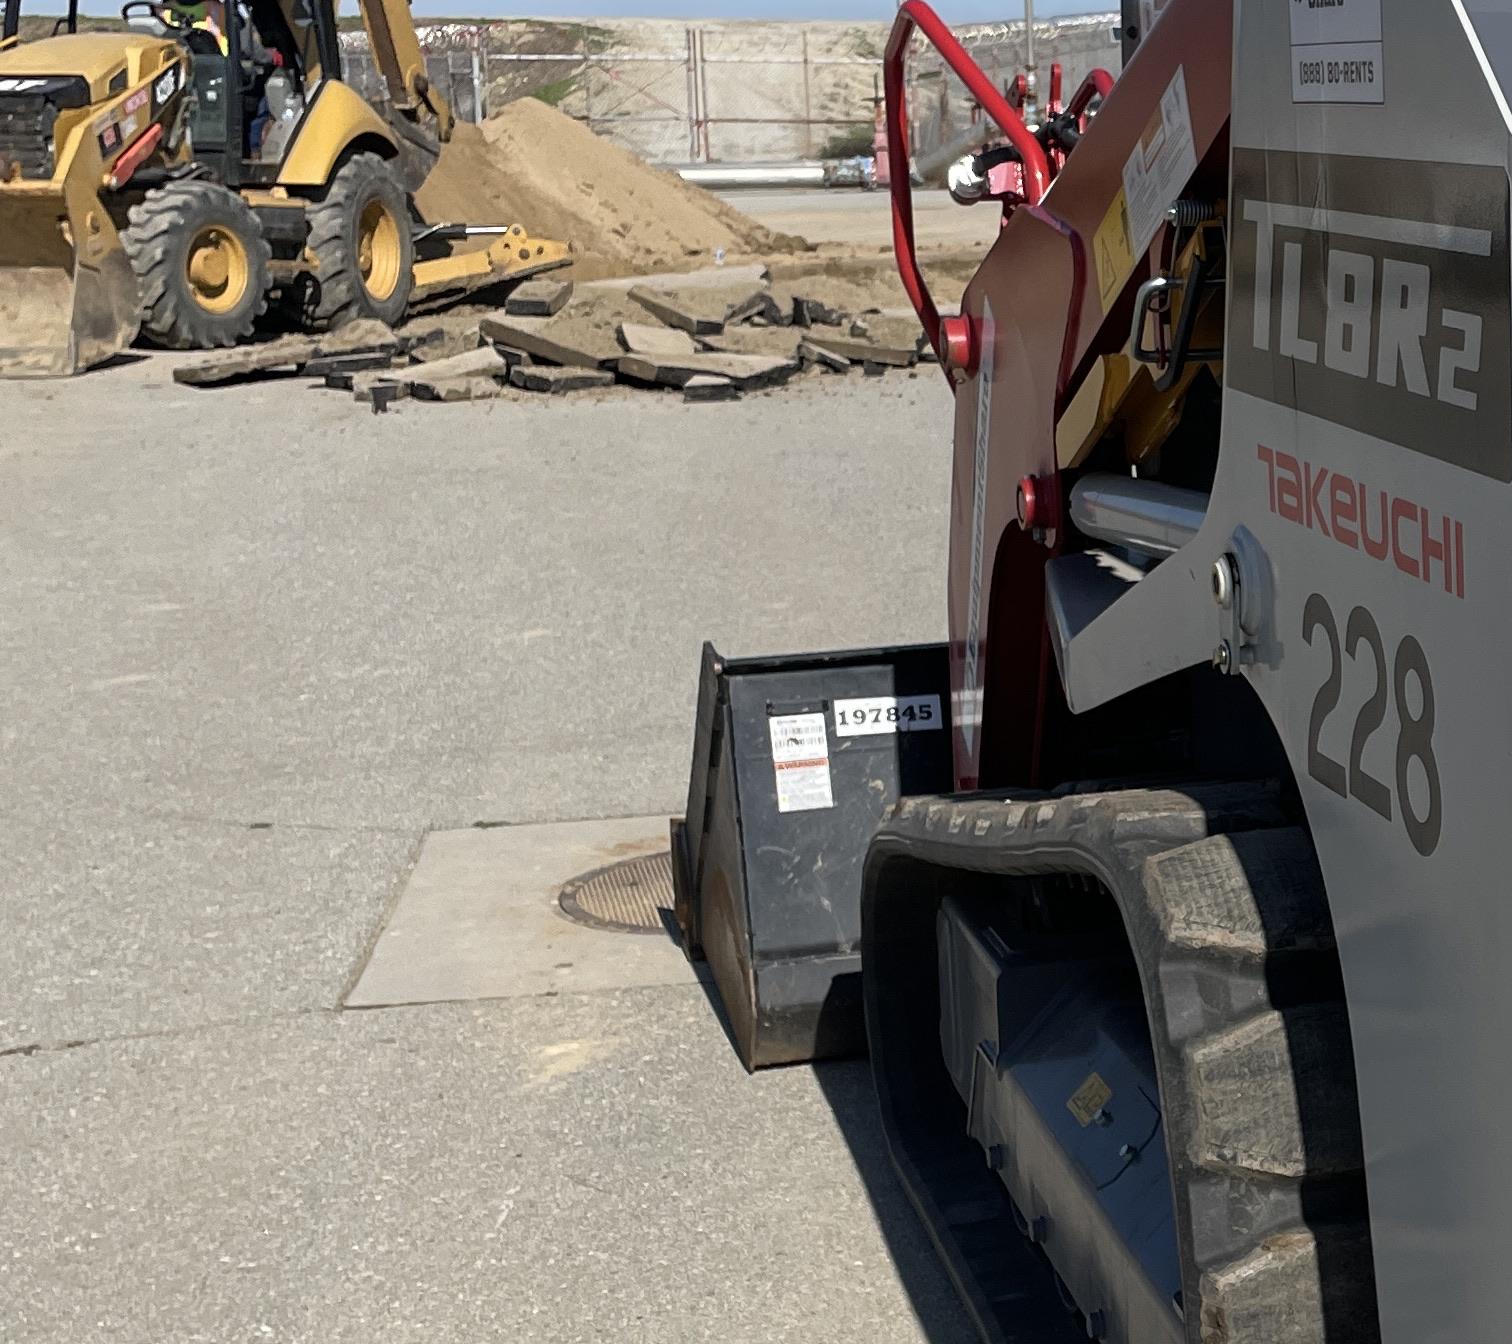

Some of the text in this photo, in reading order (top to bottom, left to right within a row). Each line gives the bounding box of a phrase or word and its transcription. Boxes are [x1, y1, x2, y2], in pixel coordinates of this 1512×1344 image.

[1300, 60, 1374, 86] (888) 80-RENTS
[1257, 444, 1465, 600] TAKEUCHI
[838, 704, 934, 726] 197845
[1302, 592, 1443, 857] 228
